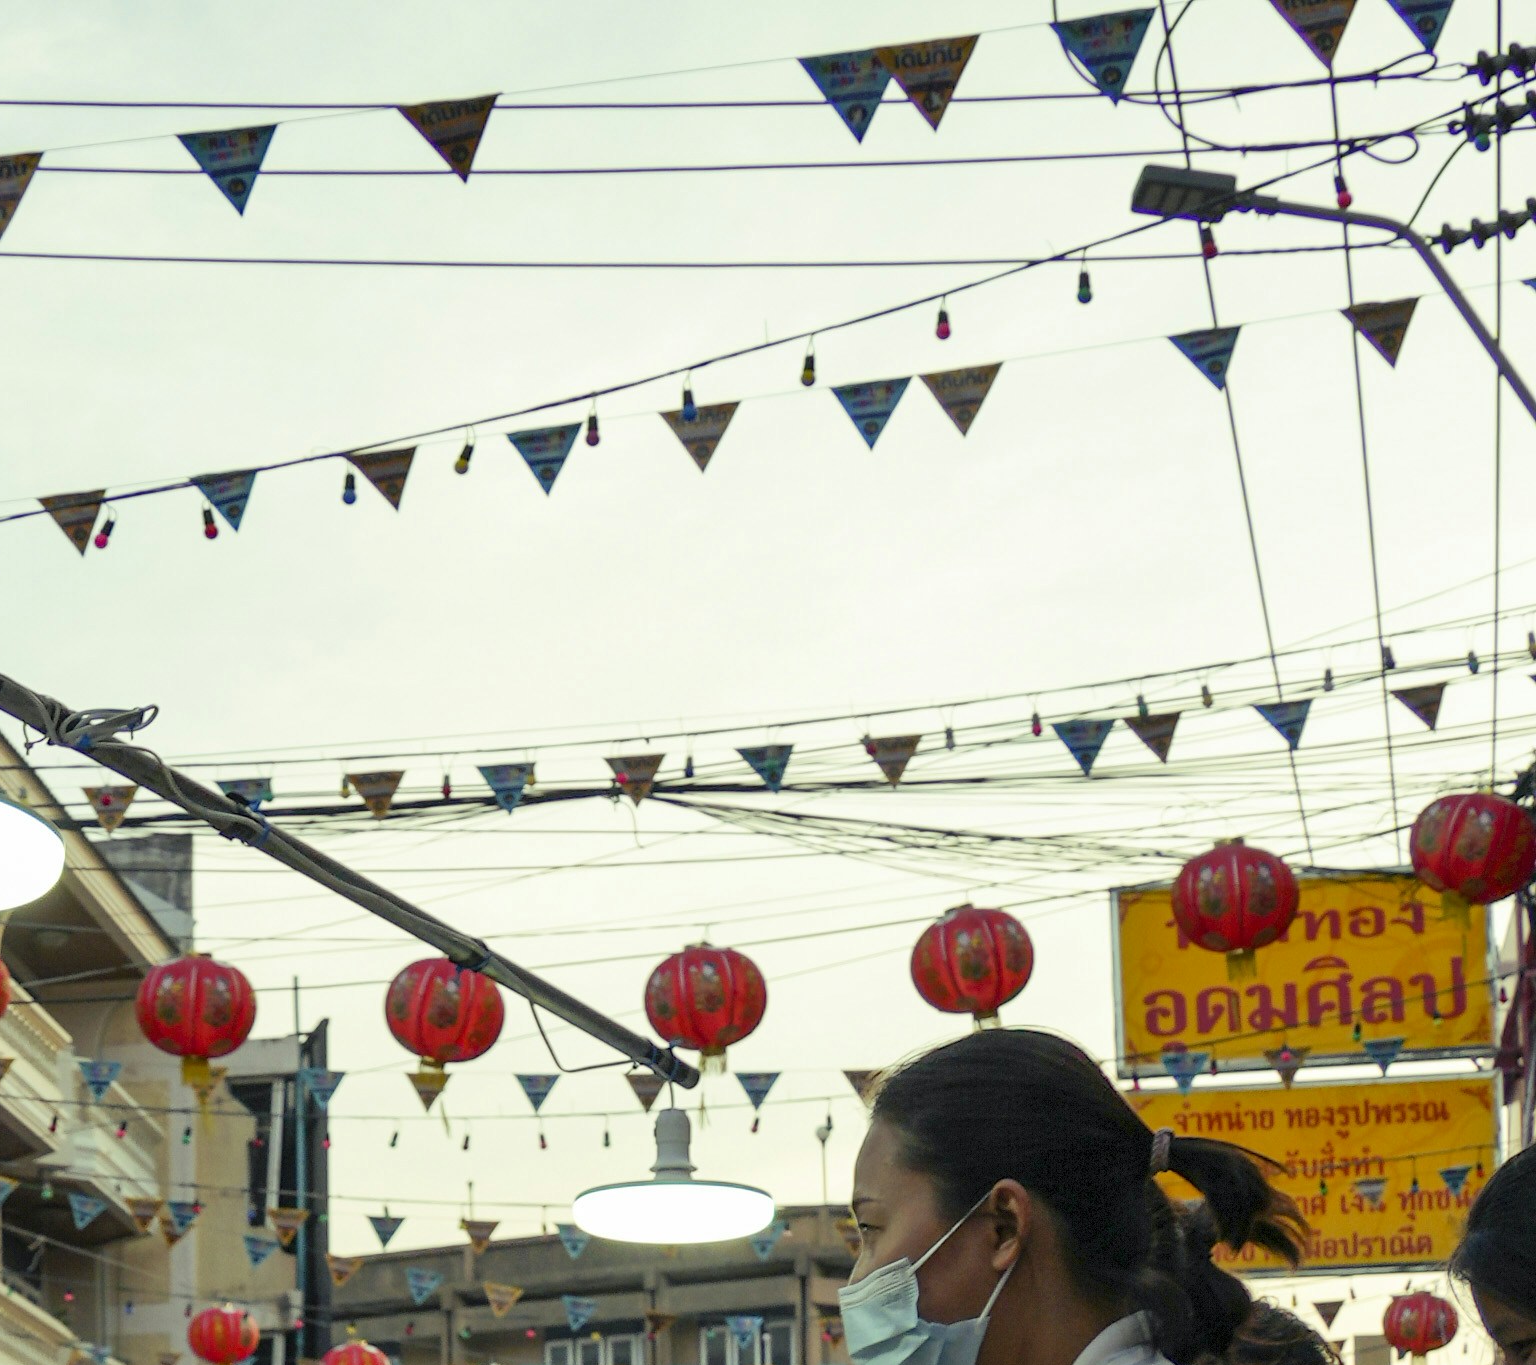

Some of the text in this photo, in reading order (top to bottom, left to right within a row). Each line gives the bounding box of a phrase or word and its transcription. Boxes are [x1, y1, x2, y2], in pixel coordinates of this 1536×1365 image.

[1173, 1099, 1450, 1139] จำหน่าย ทองรูปพรรณ
